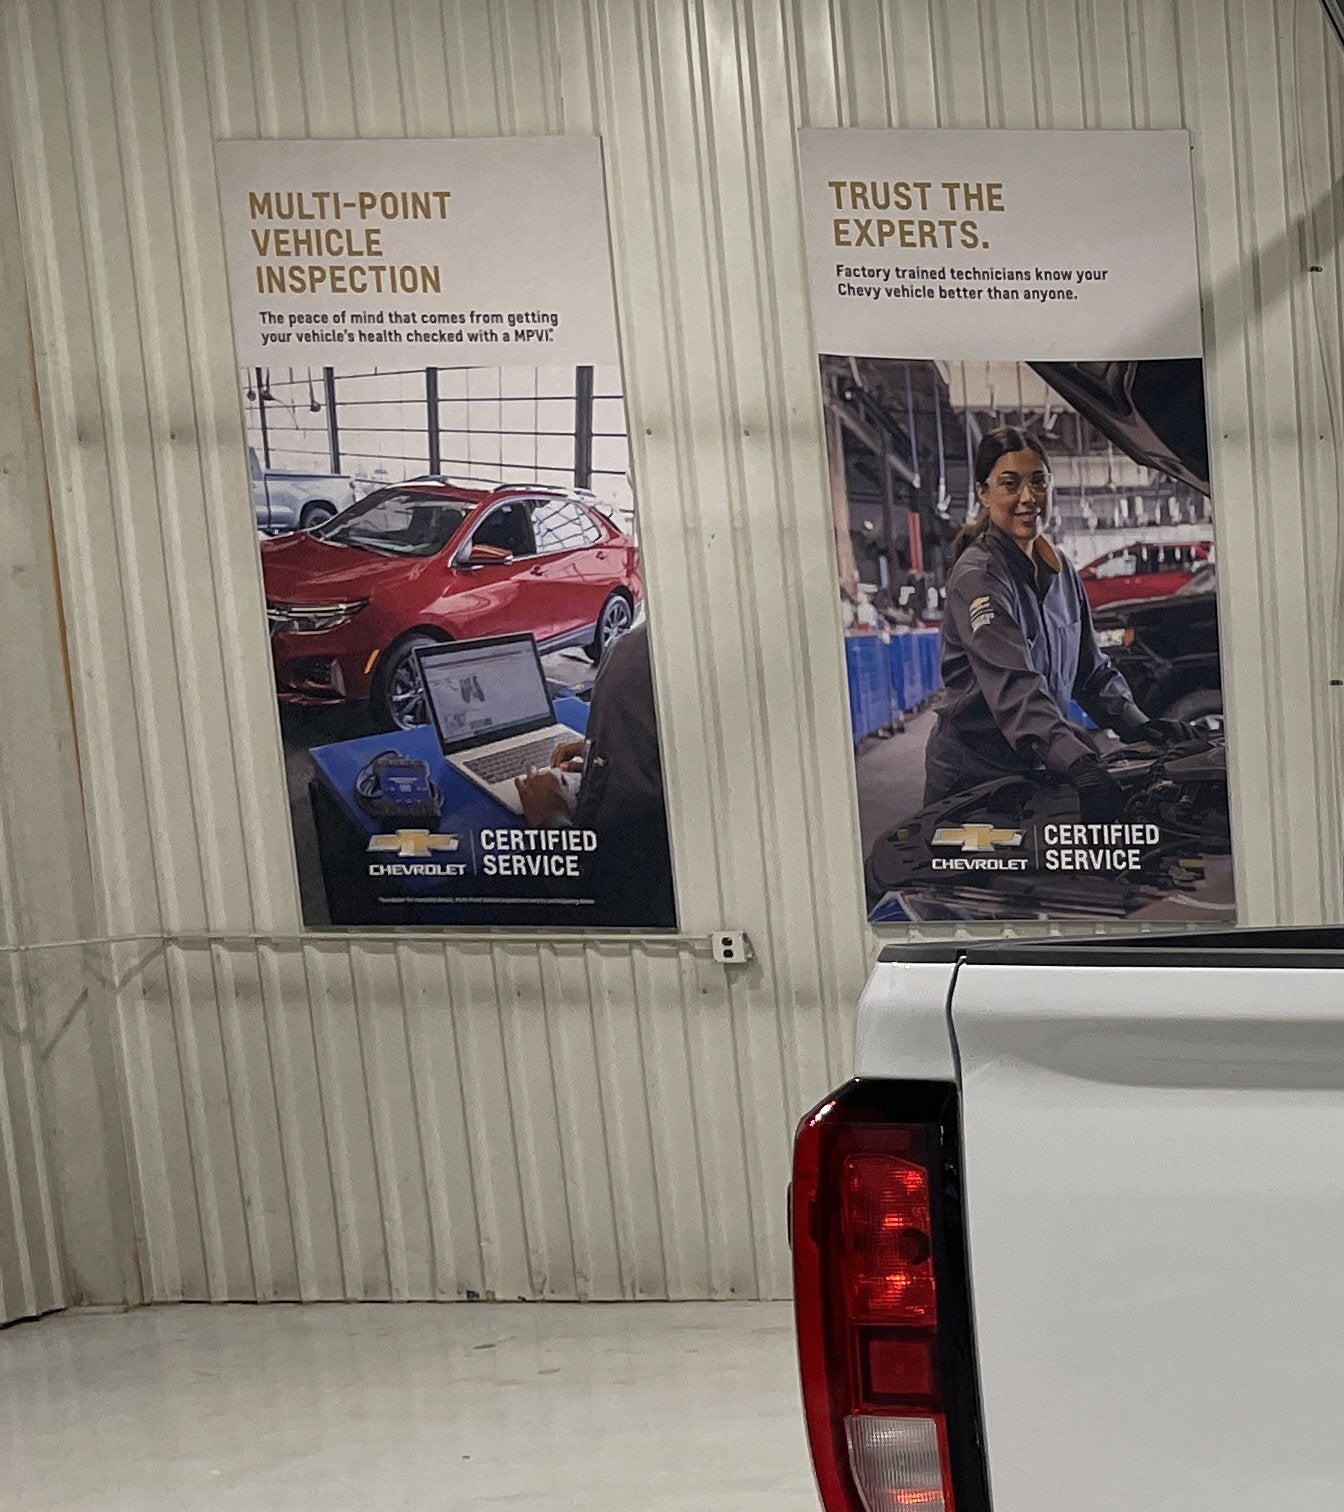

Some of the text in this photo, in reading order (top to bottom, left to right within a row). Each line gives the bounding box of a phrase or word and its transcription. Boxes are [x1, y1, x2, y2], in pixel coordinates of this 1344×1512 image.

[247, 191, 451, 220] MULTI-POINT
[828, 181, 1005, 212] TRUST THE
[251, 228, 383, 257] VEHICLE
[834, 218, 989, 249] EXPERTS.
[256, 265, 441, 294] INSPECTION
[836, 264, 1108, 283] Factory trained technicians know your
[838, 283, 1078, 303] Chevy vehicle better than anyone.
[259, 310, 558, 328] The peace of mind that comes from getting
[261, 332, 292, 346] your
[296, 329, 355, 343] vehicle's
[358, 329, 402, 343] health
[406, 329, 463, 343] checked
[467, 329, 498, 343] with
[502, 332, 510, 342] a
[480, 829, 598, 851] CERTIFIED
[1043, 823, 1160, 845] CERTIFIED
[369, 863, 467, 876] CHEVROLET
[483, 855, 580, 876] SERVICE
[931, 858, 1028, 871] CHEVROLET
[1045, 849, 1142, 870] SERVICE
